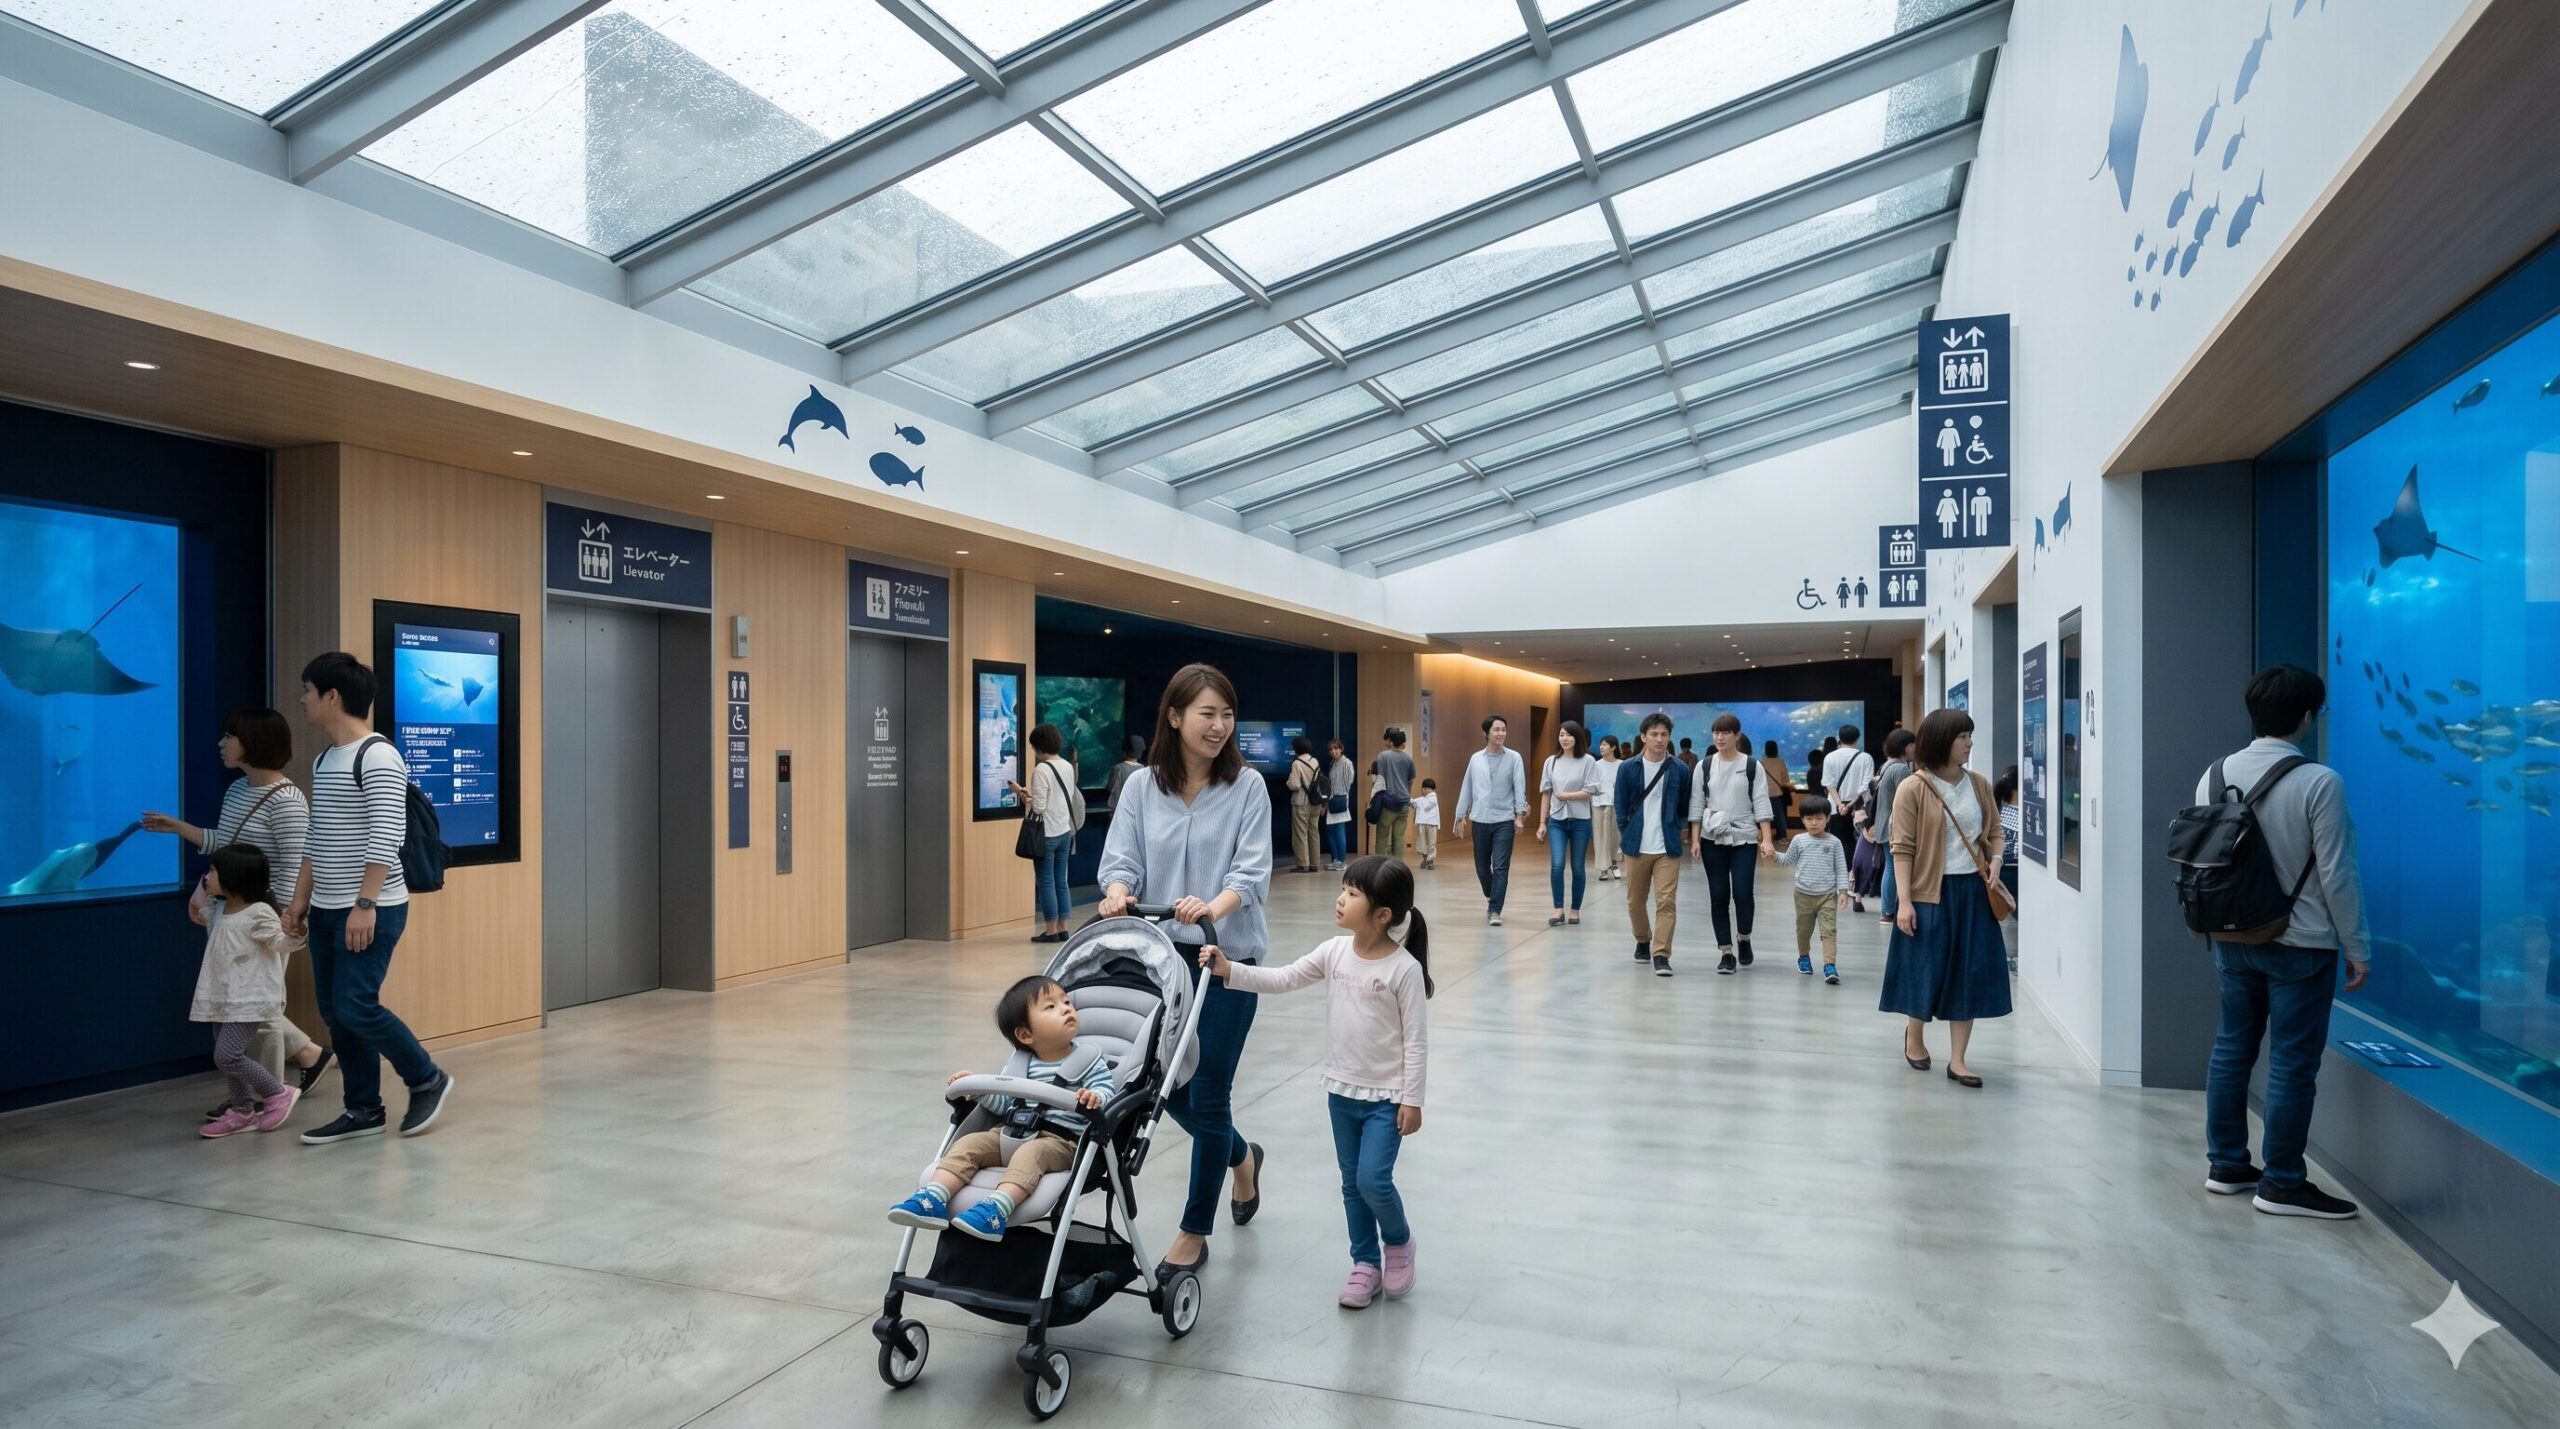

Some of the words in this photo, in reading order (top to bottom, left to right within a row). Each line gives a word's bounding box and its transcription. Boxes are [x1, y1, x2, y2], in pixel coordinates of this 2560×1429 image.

[623, 546, 690, 567] エレベーター
[894, 582, 930, 597] ファミリー
